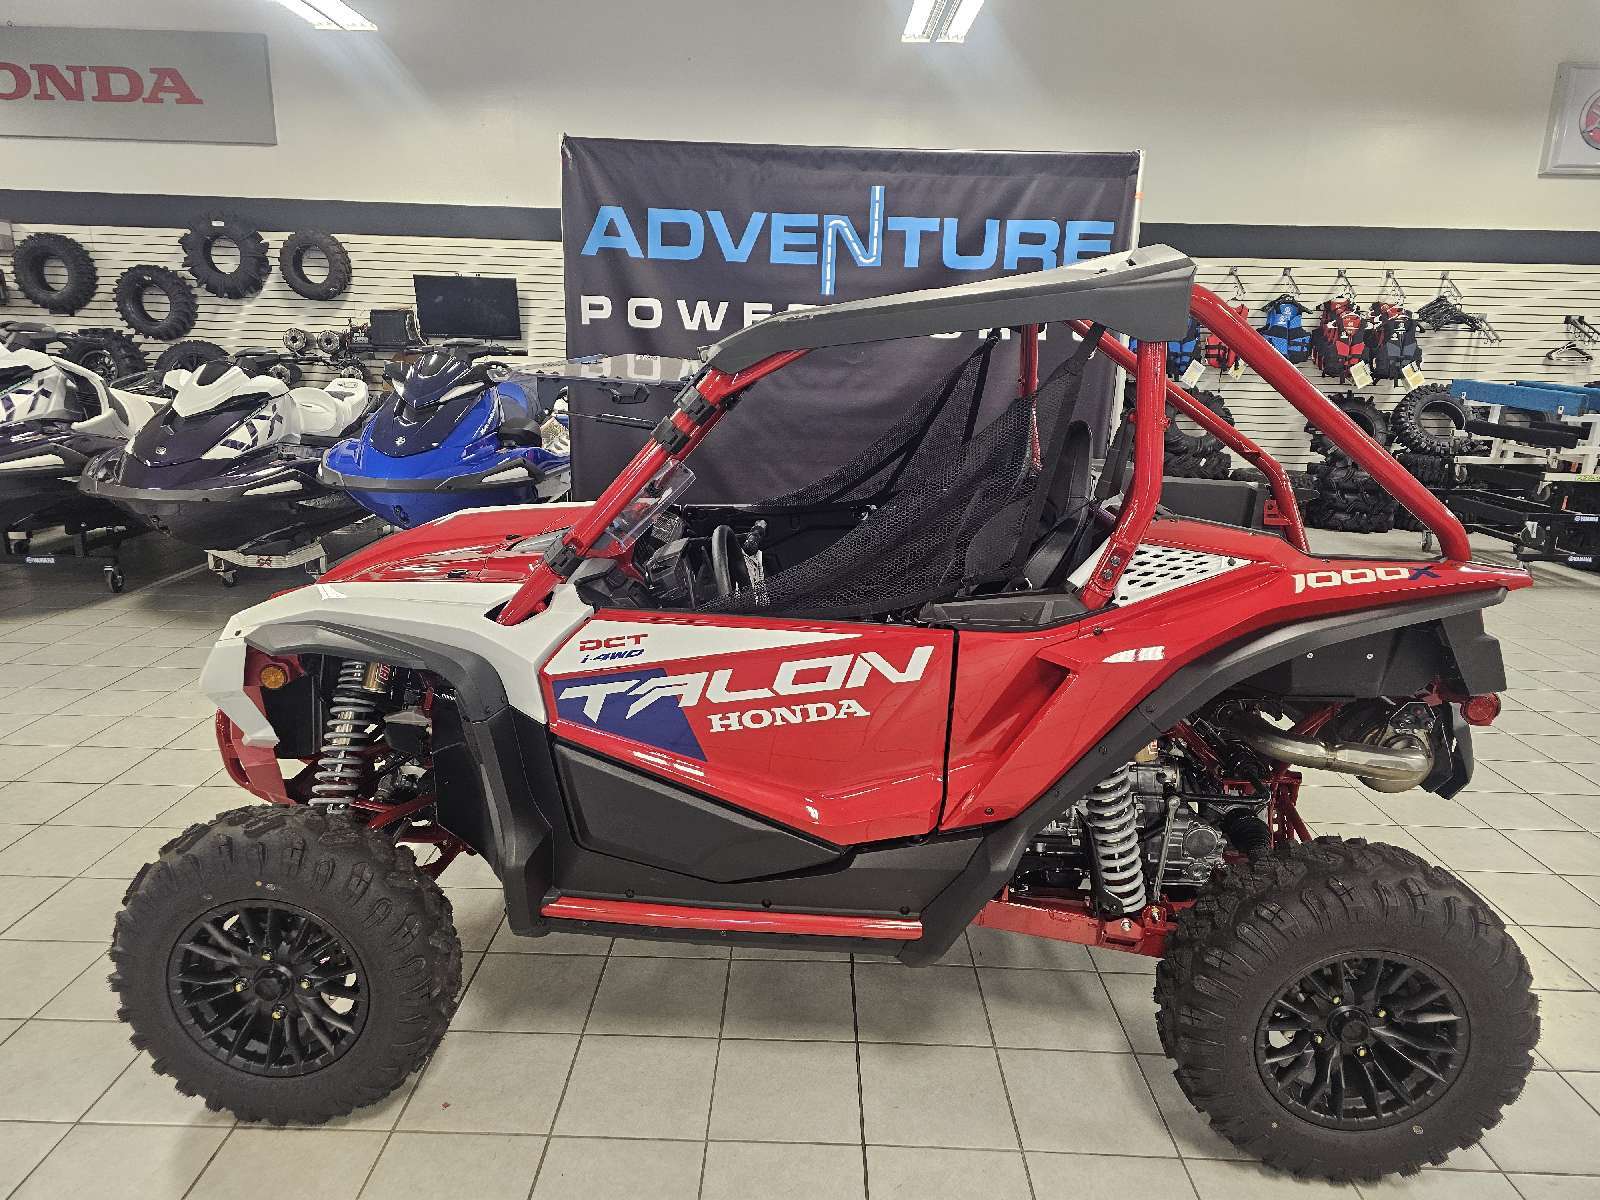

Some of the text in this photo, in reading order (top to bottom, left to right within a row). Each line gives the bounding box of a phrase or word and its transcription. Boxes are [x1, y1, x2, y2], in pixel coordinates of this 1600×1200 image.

[580, 185, 1115, 296] ADVENTURE
[1291, 566, 1441, 594] 1000X
[579, 633, 649, 651] DCT
[559, 645, 935, 724] TALON
[707, 699, 871, 733] HONDA
